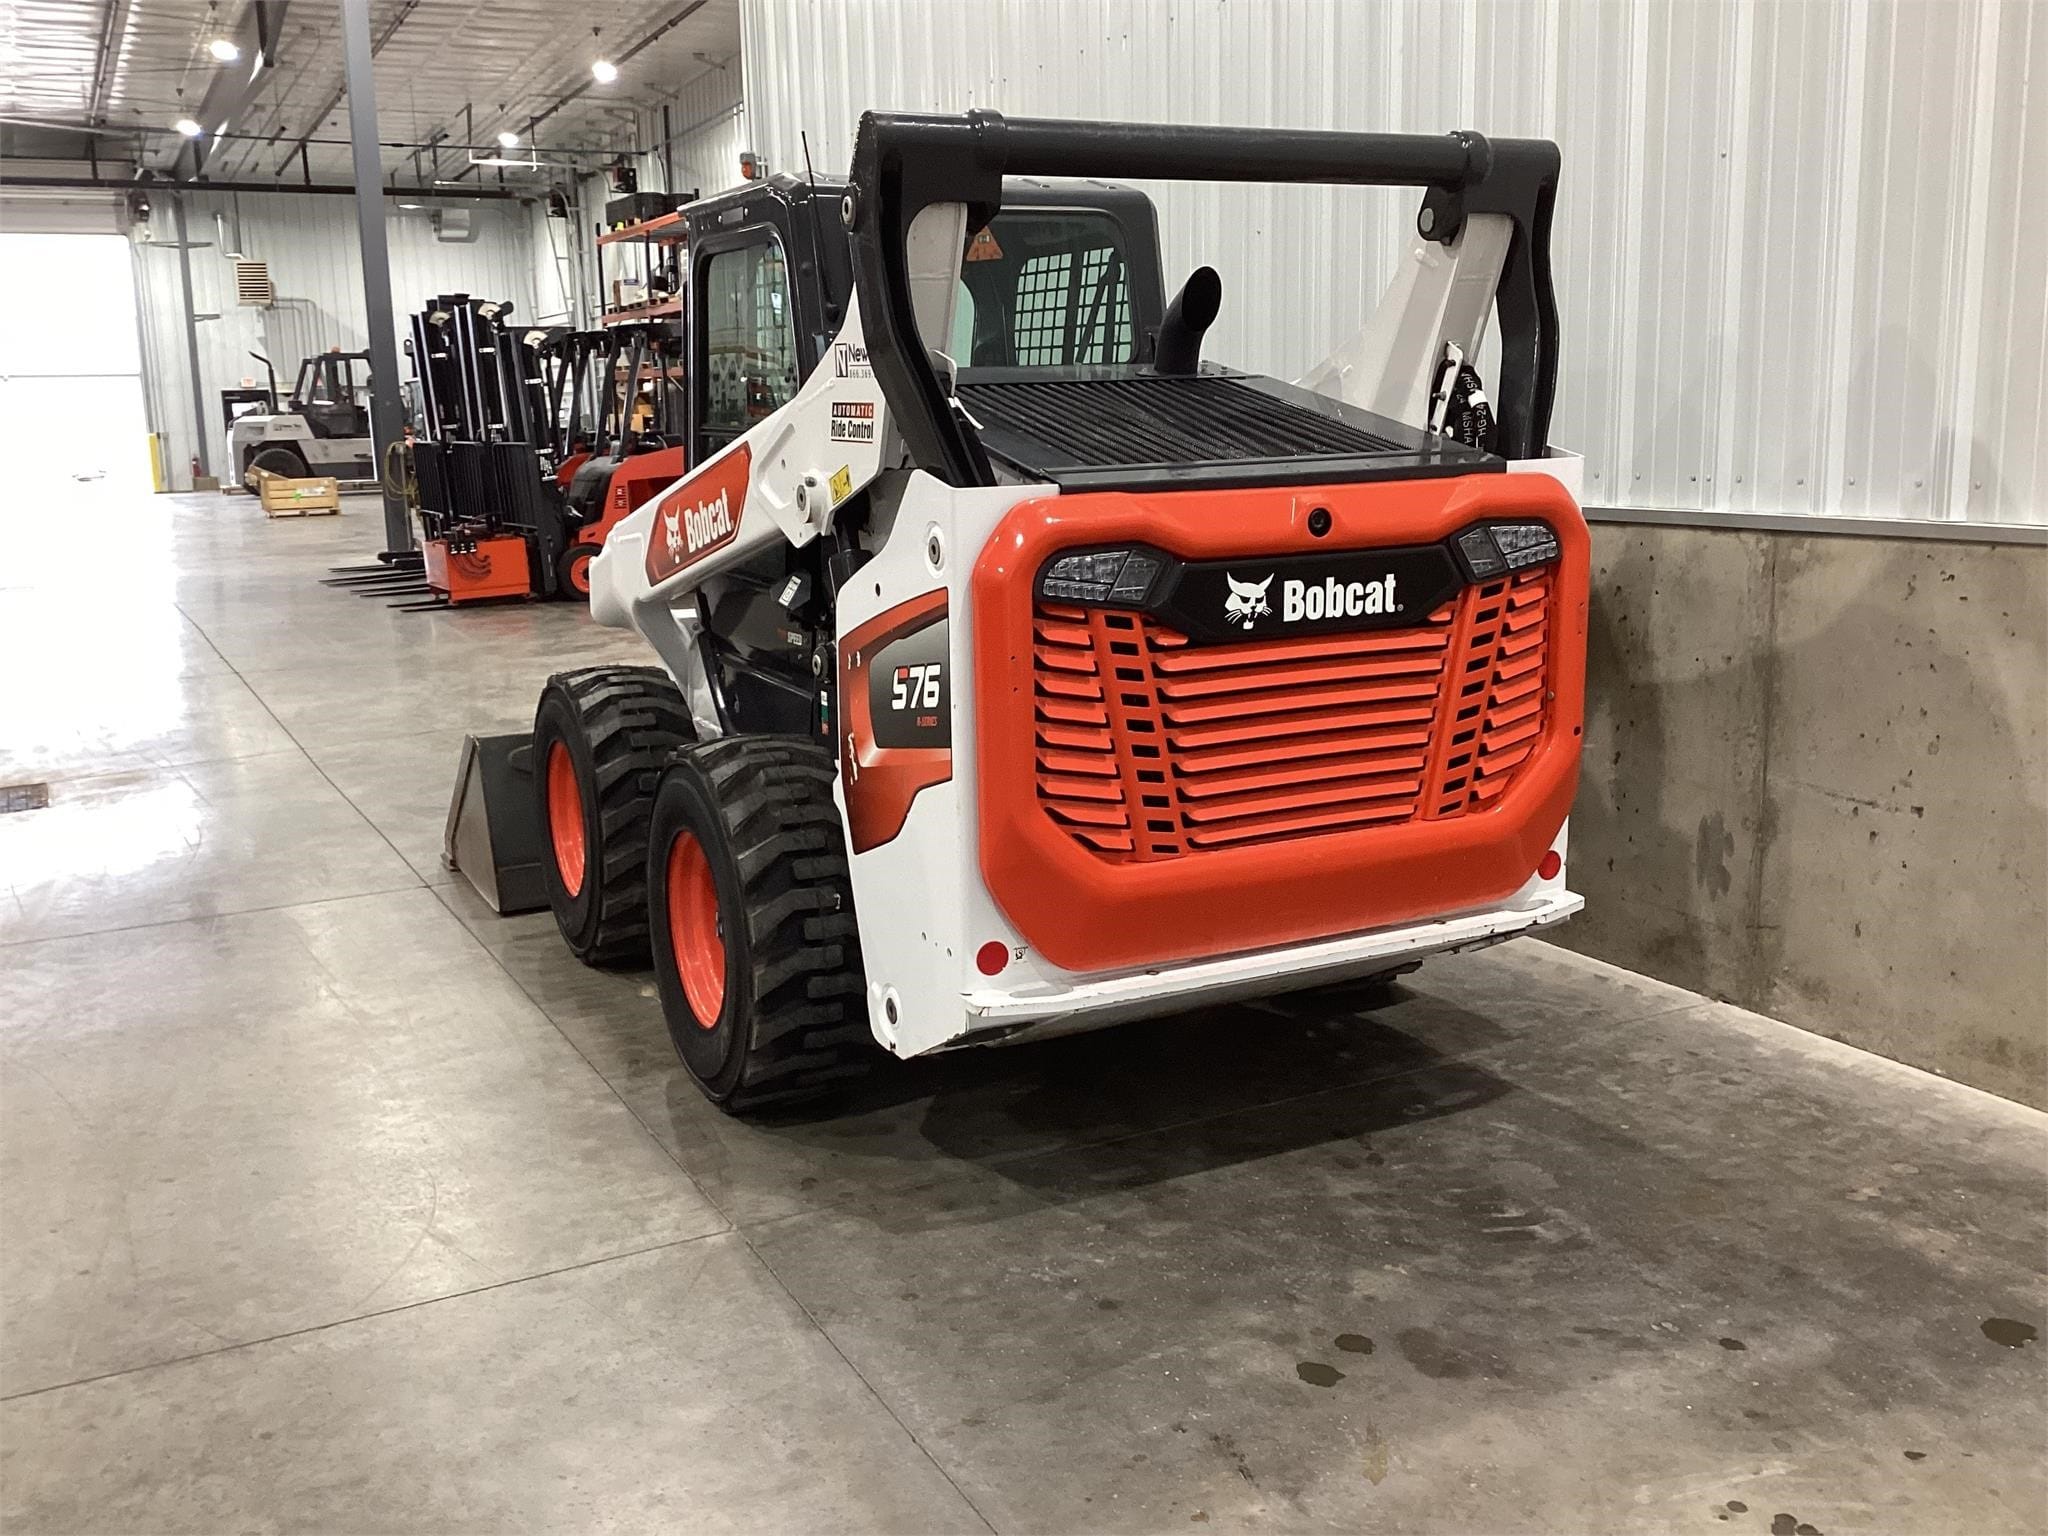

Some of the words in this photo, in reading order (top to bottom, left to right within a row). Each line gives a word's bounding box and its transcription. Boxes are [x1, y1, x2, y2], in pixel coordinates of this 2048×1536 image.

[831, 420, 846, 437] Ride
[848, 420, 873, 439] Control
[833, 404, 873, 417] AUTOMATIC
[684, 487, 732, 554] Bobcat
[1283, 573, 1396, 622] Bobcat
[891, 664, 941, 710] S76
